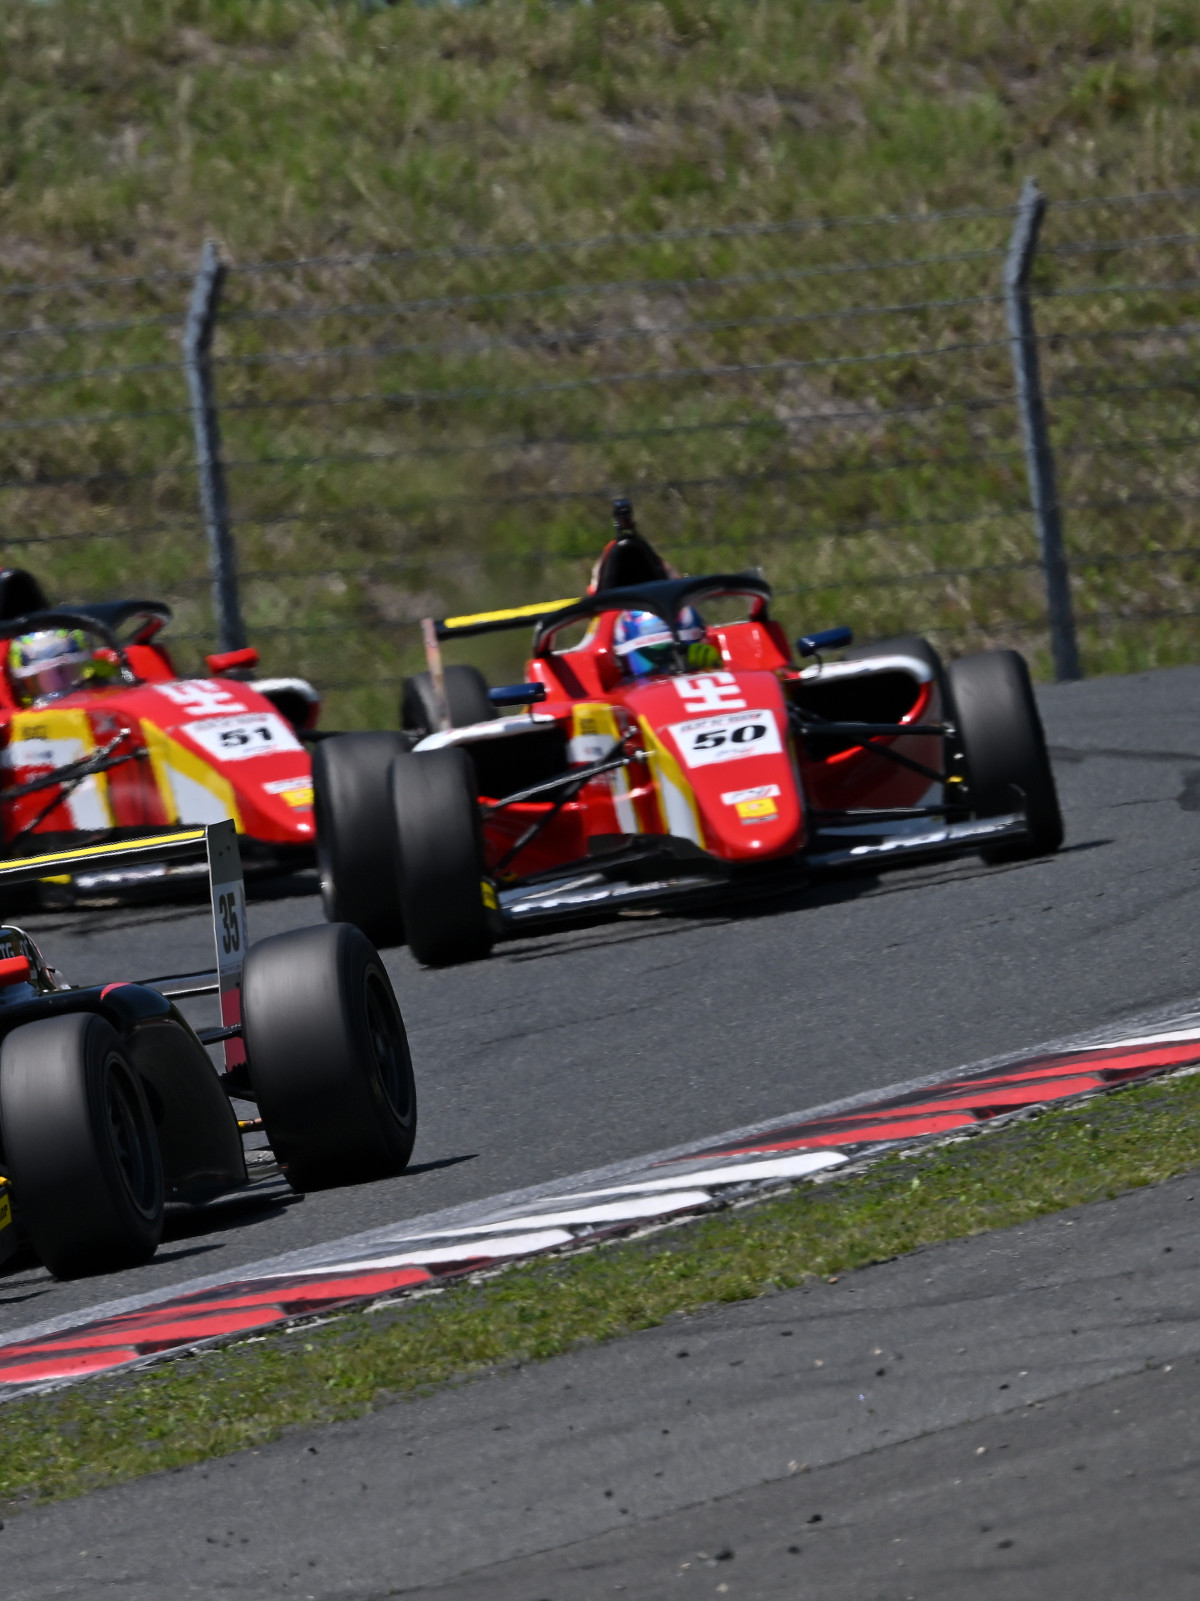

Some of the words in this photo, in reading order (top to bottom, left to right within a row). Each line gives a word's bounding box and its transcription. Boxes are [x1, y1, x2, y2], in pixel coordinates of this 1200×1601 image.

[219, 726, 272, 748] 51
[692, 725, 767, 750] 50
[219, 892, 240, 955] 35
